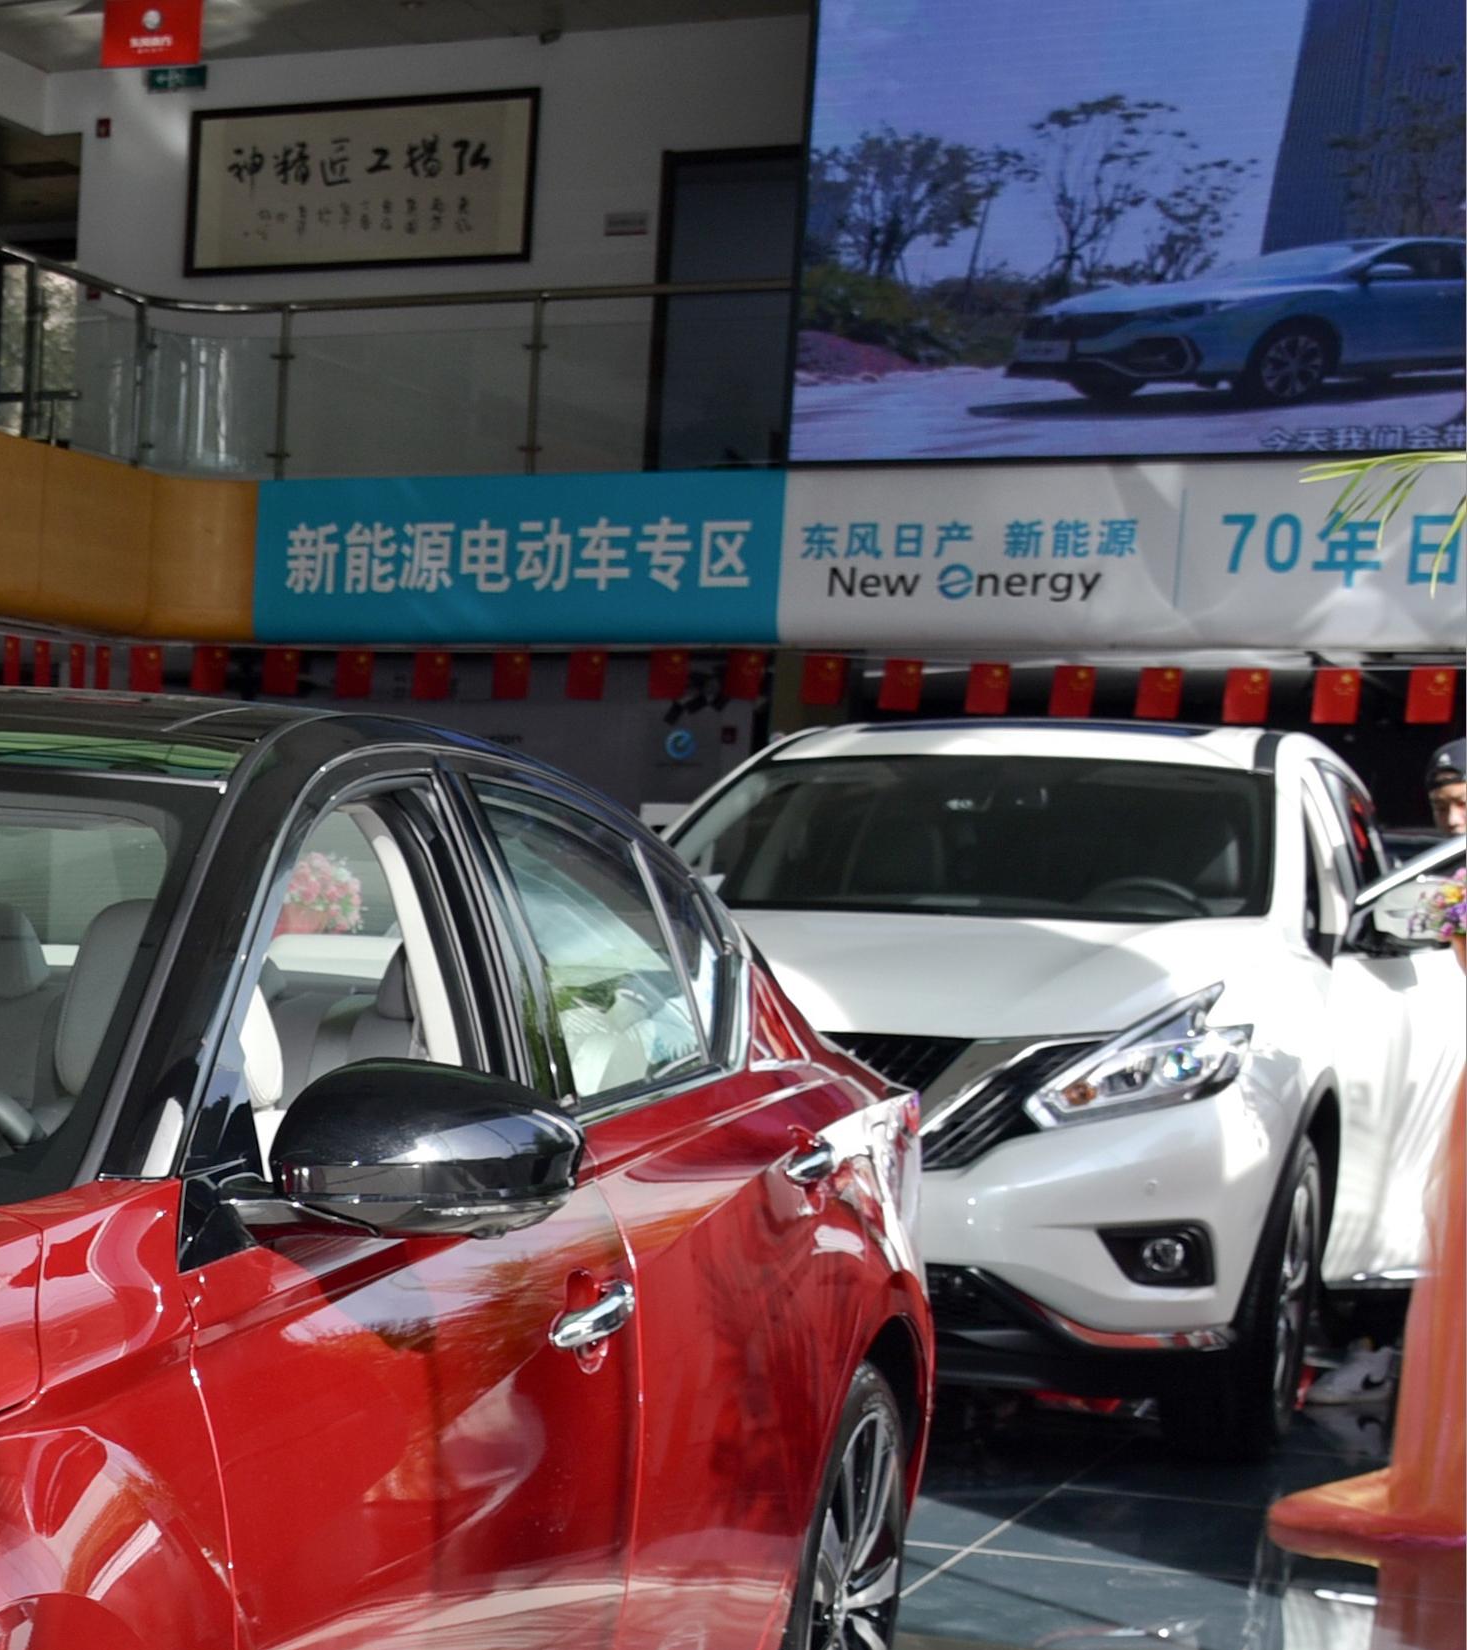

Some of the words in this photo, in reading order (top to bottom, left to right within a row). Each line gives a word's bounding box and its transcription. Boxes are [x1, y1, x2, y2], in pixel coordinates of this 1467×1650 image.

[285, 515, 754, 595] 新能源电动车专区
[800, 520, 974, 560] 东风日产
[1003, 518, 1139, 560] 新能源
[827, 565, 920, 599] New
